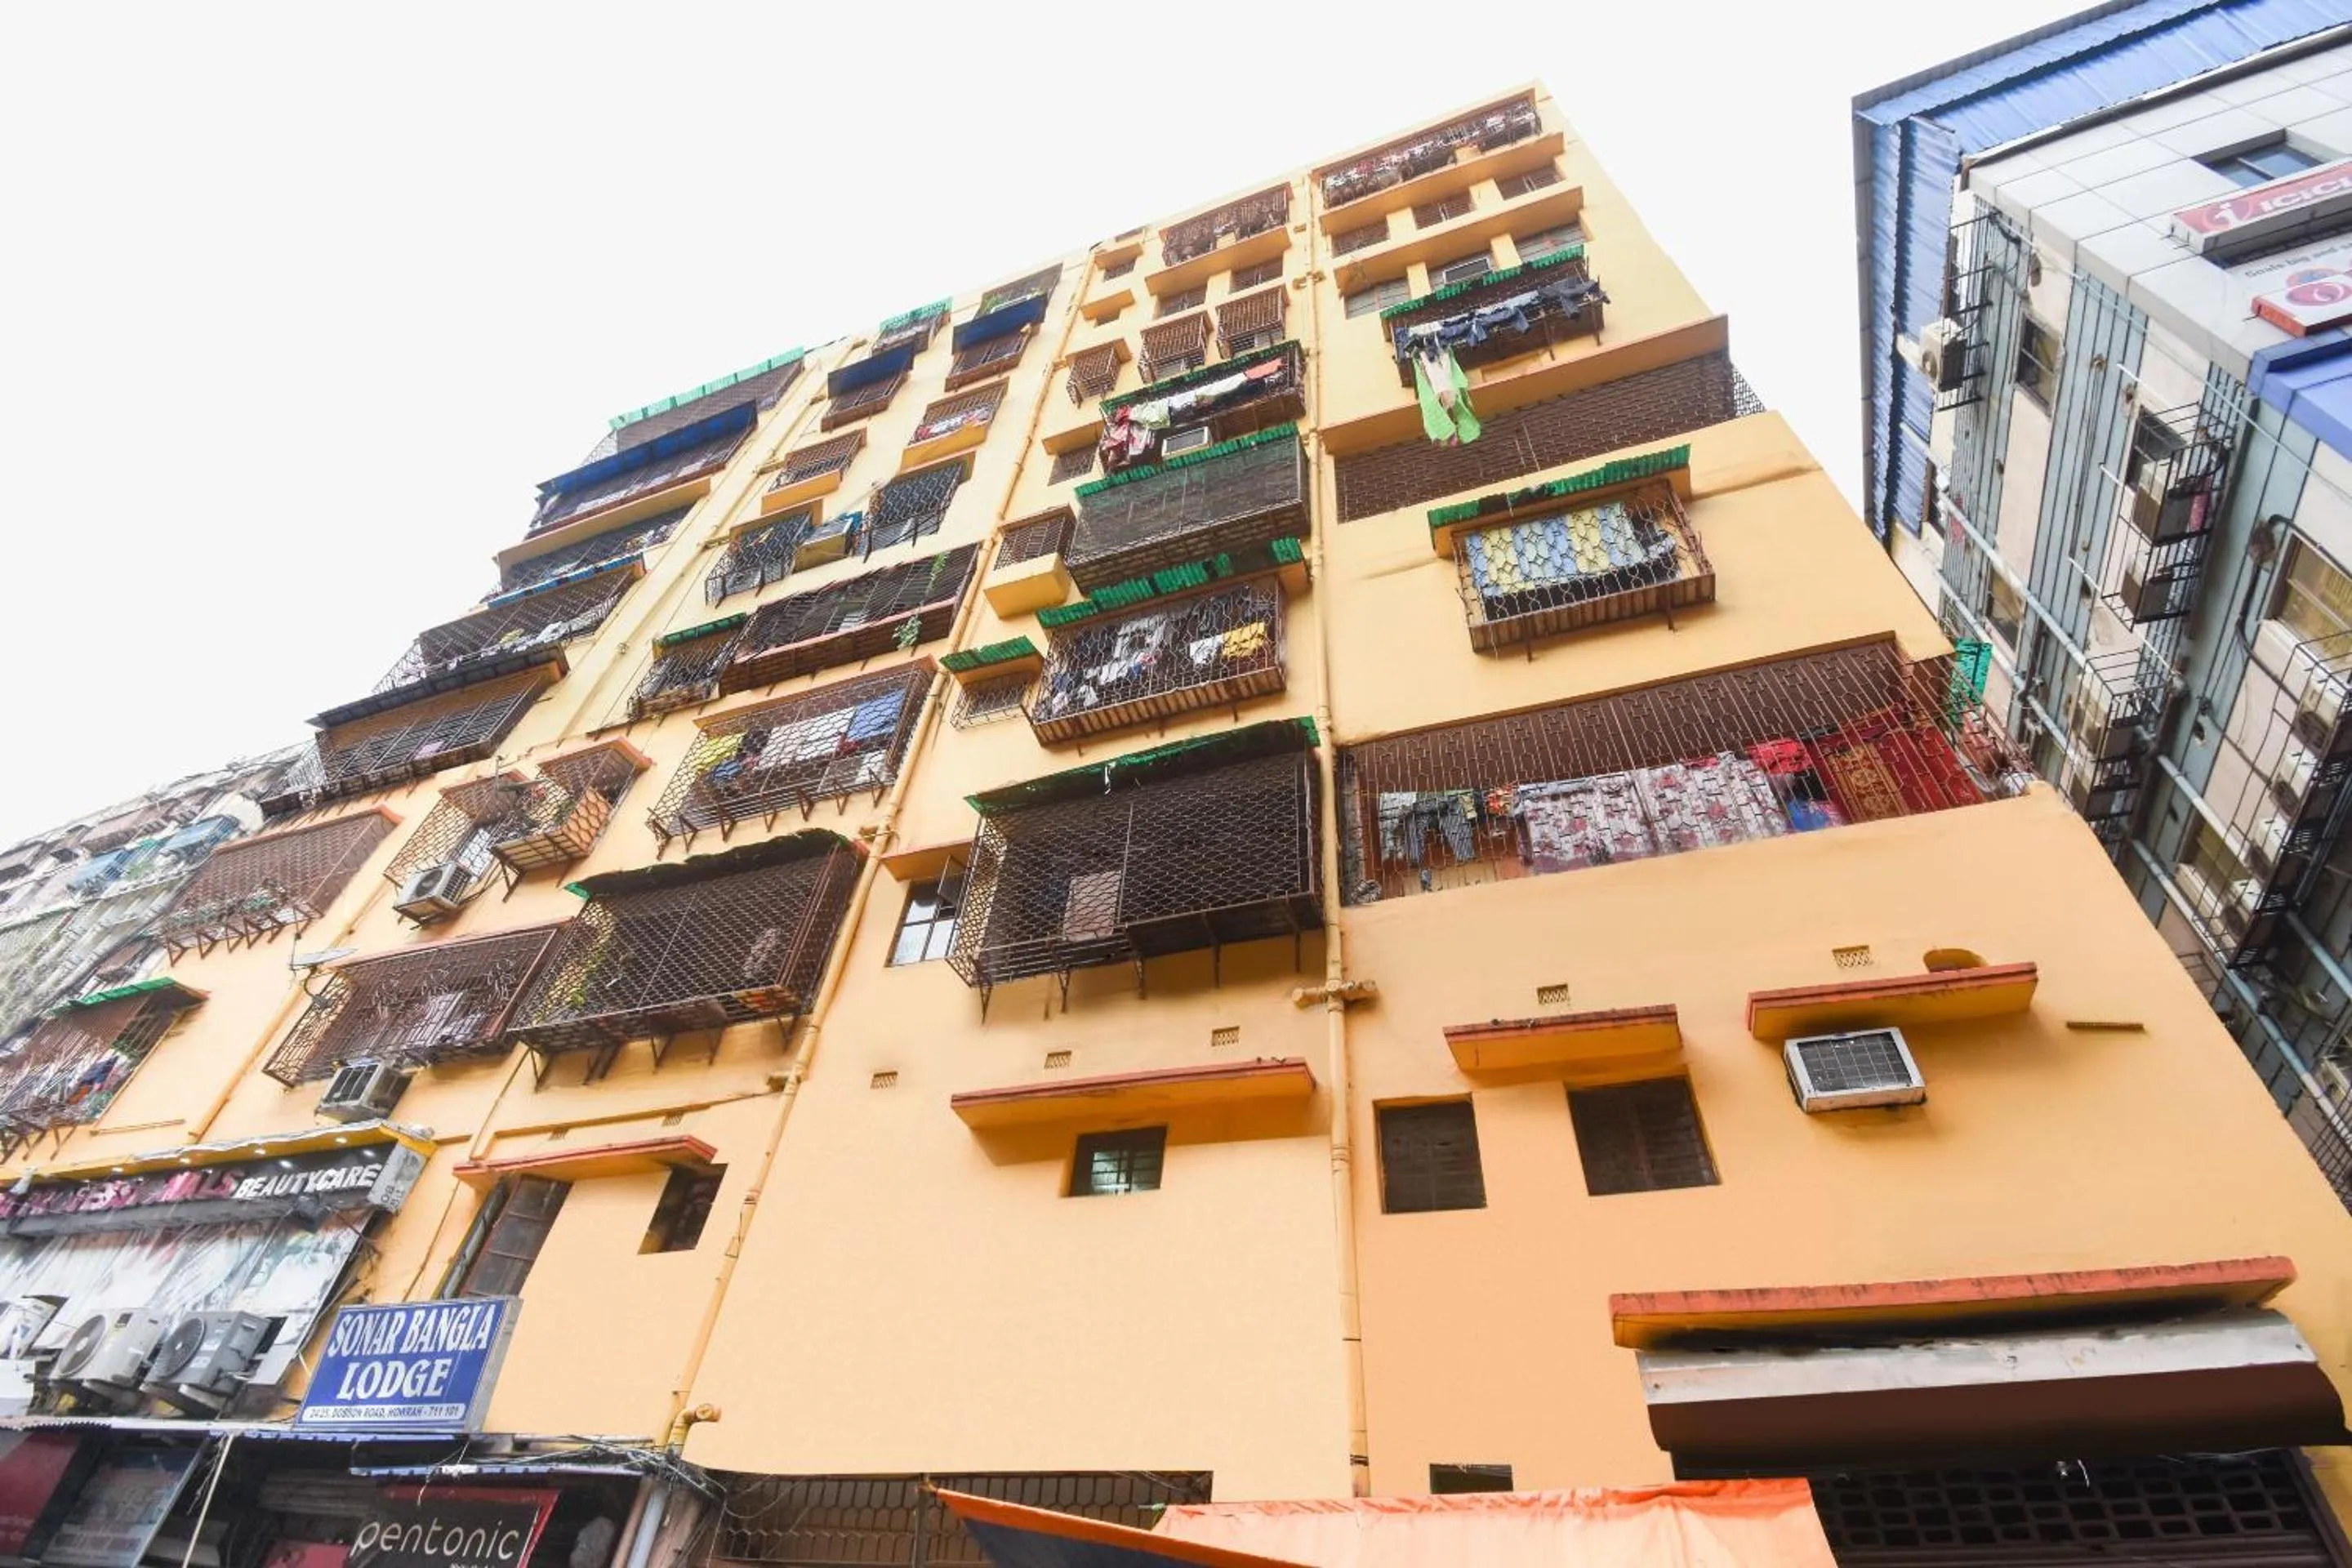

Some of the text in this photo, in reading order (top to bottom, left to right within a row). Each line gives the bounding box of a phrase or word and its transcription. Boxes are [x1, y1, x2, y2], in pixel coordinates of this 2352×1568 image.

[327, 1304, 497, 1357] SONAR BANGLA
[336, 1359, 452, 1401] LODGE
[349, 1517, 520, 1560] pentonic
